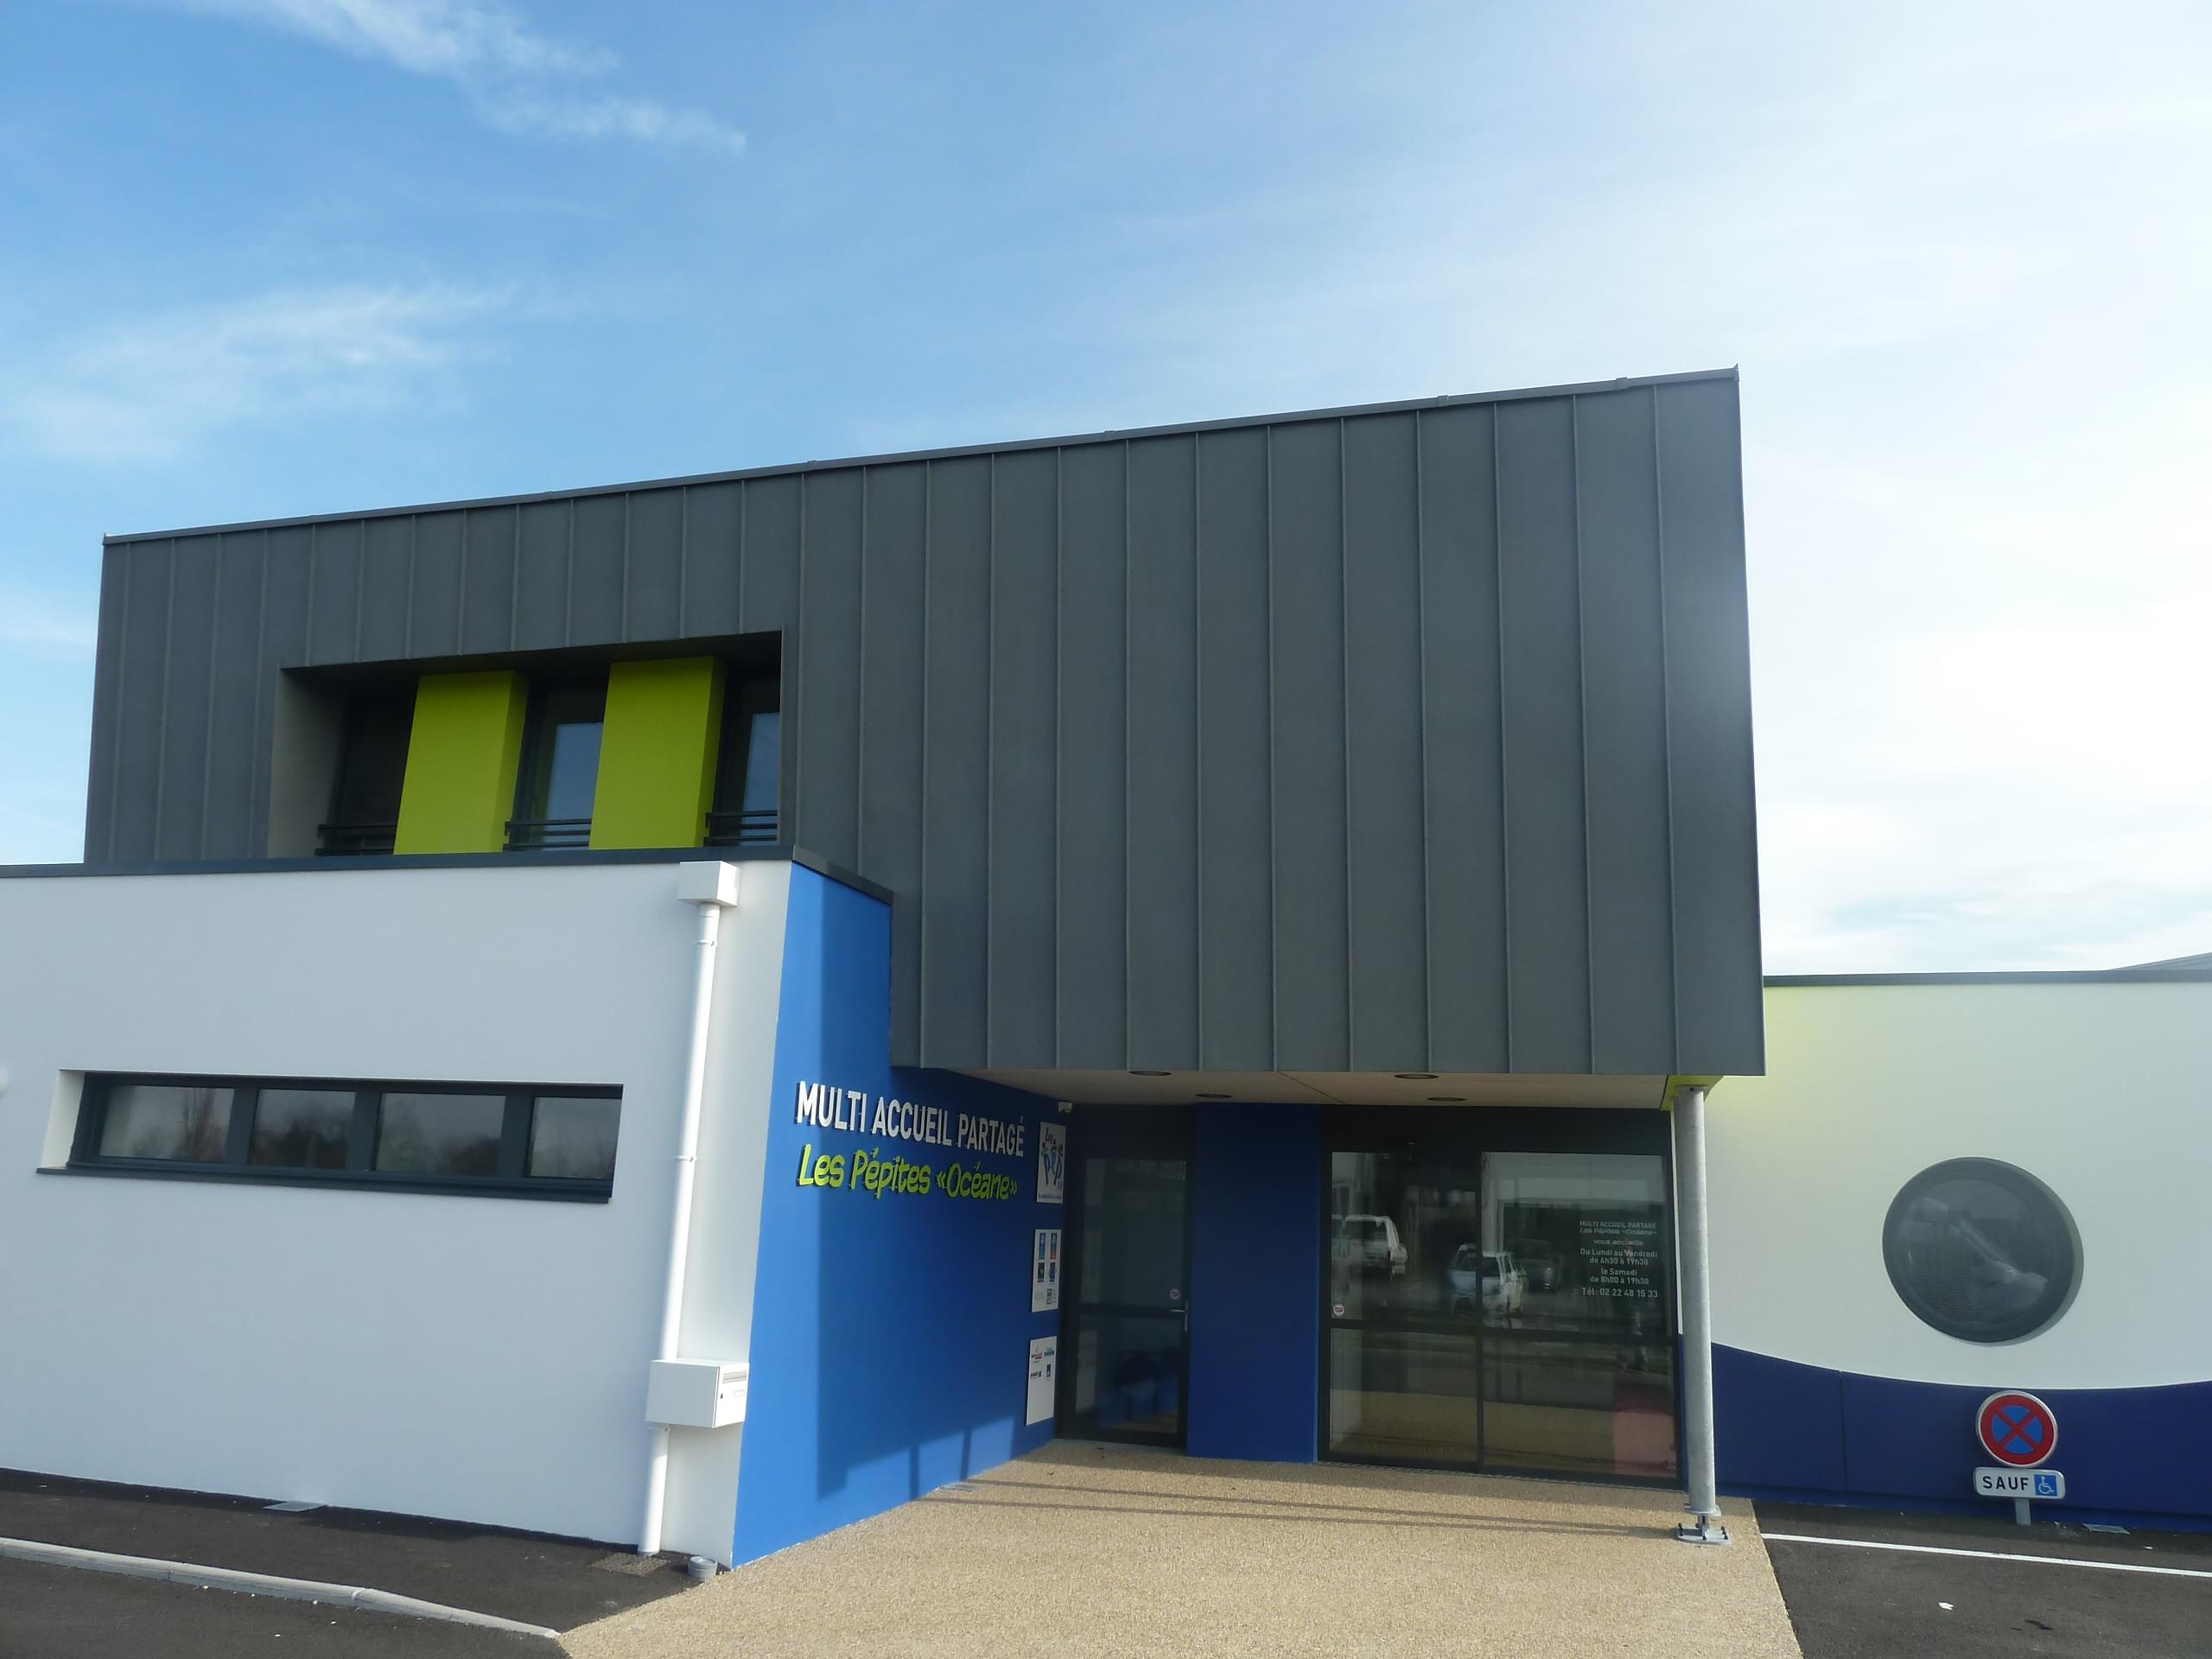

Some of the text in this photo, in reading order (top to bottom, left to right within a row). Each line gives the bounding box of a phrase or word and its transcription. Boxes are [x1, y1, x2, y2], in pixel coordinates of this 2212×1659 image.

[796, 1080, 1026, 1157] MULTI ACCUEIL PARTAGÉ
[797, 1143, 1018, 1200] Les Pépites «Océane»
[1592, 1248, 1612, 1256] Lundi
[1624, 1249, 1657, 1258] Vendredi
[1626, 1257, 1649, 1266] 19h30
[1610, 1268, 1637, 1276] Samedi
[1599, 1287, 1610, 1296] 02
[1611, 1288, 1622, 1297] 22
[1624, 1288, 1634, 1297] 48
[1637, 1289, 1646, 1298] 15
[1647, 1289, 1658, 1298] 33
[1982, 1476, 2030, 1491] SAUF
